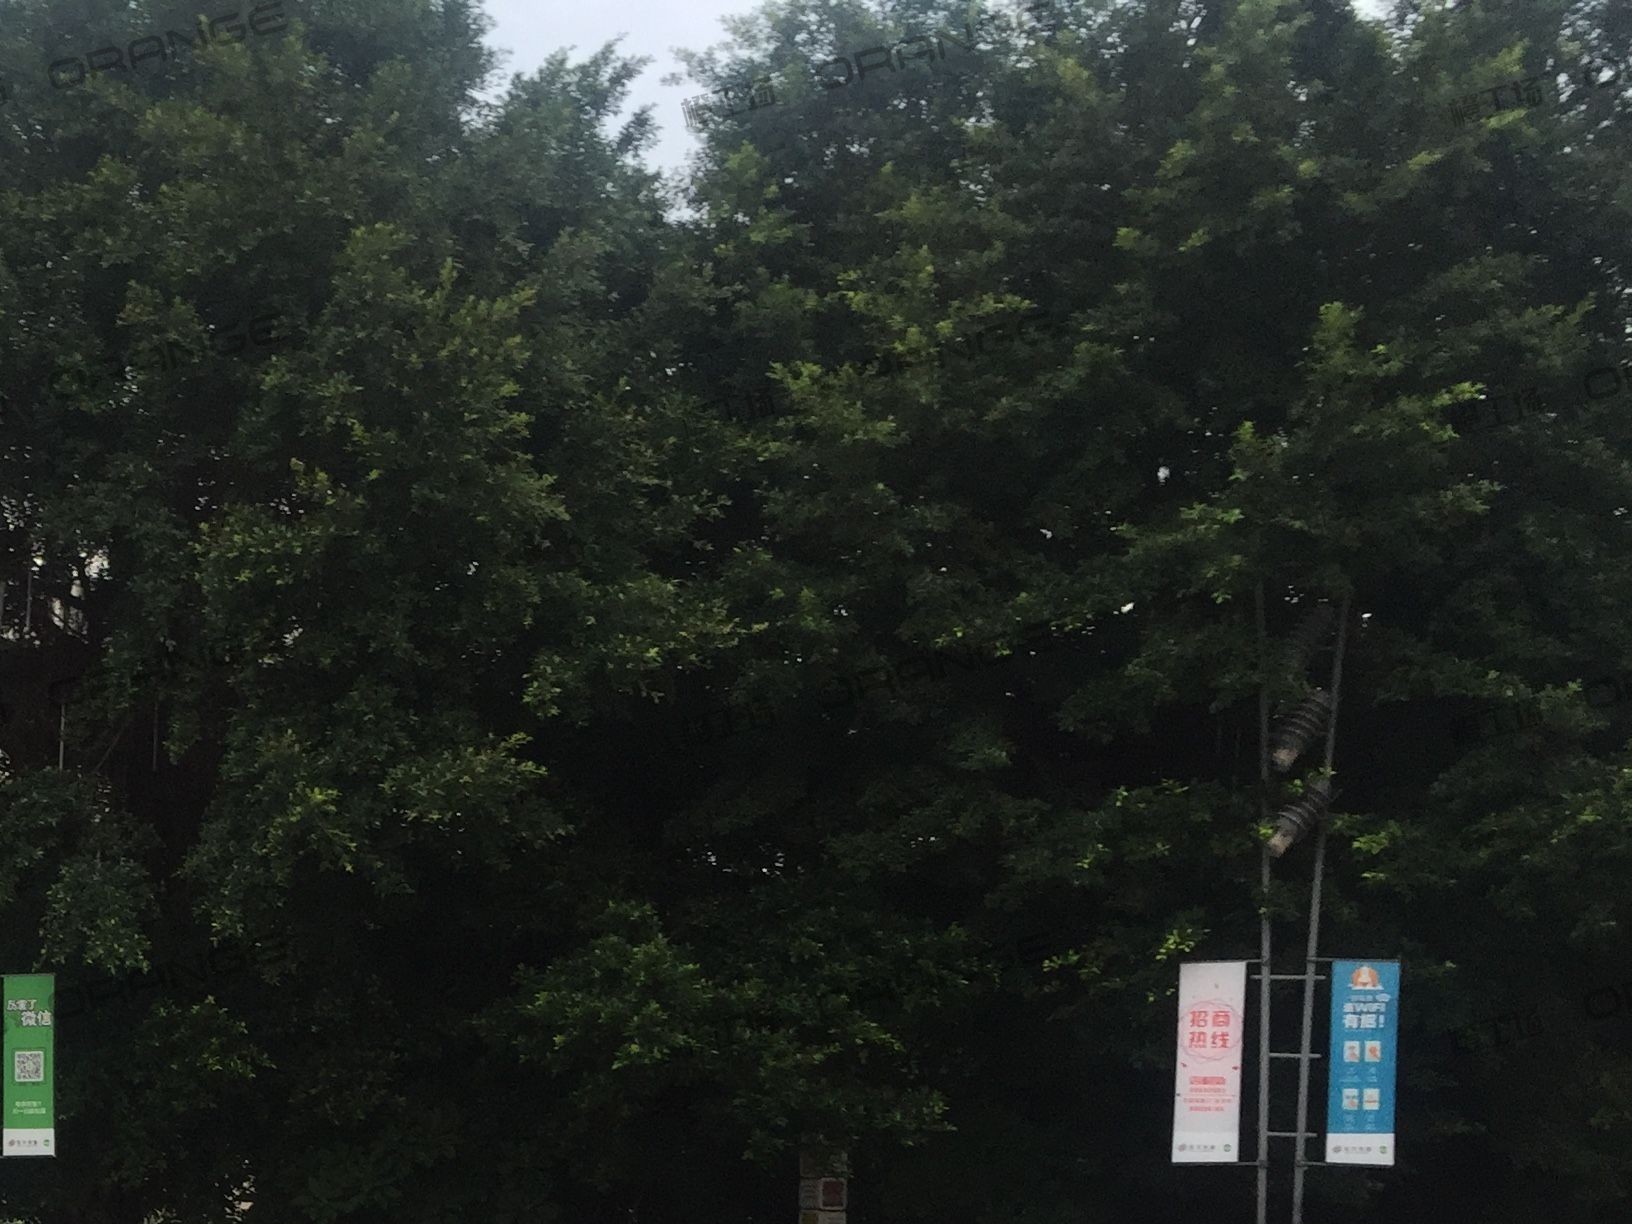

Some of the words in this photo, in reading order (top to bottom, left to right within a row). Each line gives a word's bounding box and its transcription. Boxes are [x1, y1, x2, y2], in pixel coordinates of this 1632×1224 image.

[20, 1009, 53, 1027] 微信
[1189, 1011, 1231, 1029] 招商
[1188, 1031, 1230, 1049] 热线
